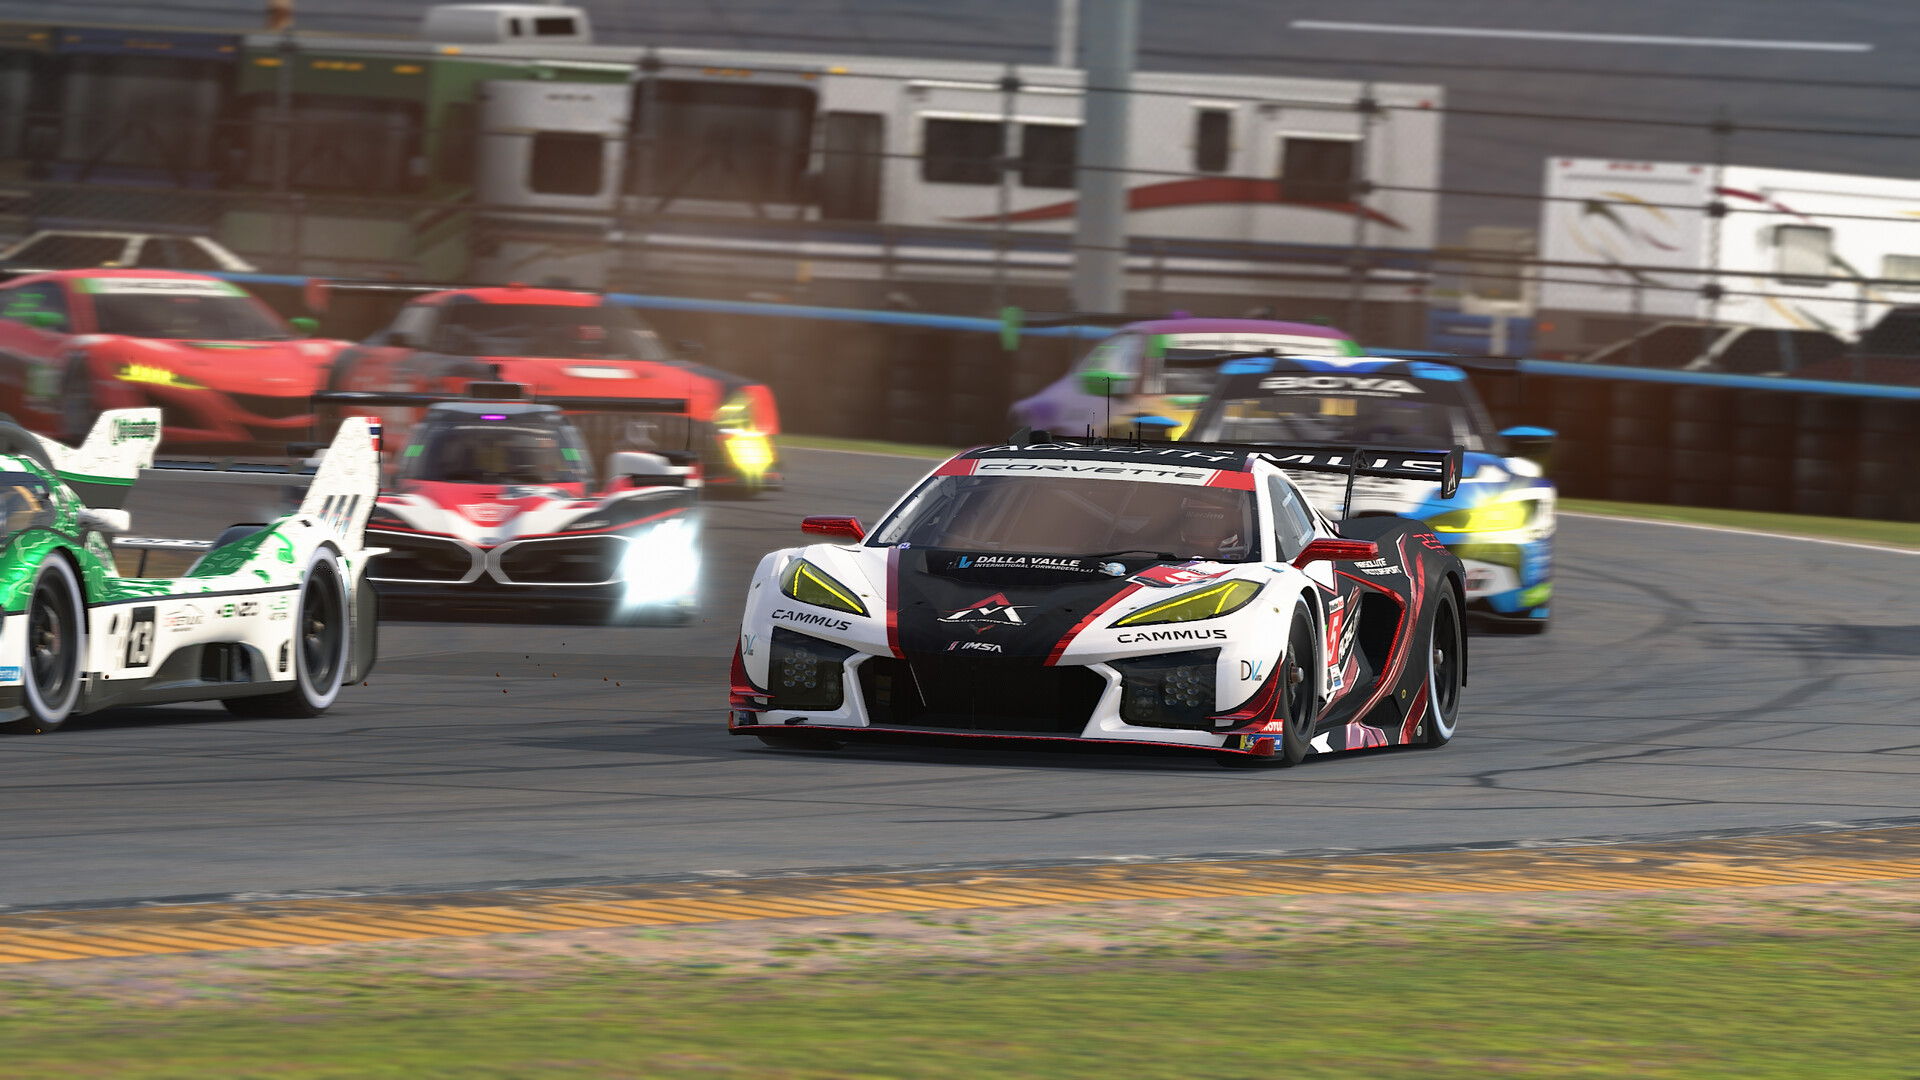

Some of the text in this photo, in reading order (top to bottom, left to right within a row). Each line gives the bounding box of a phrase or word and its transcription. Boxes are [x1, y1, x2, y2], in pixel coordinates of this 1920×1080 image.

[1258, 377, 1425, 394] BOYA
[980, 463, 1205, 480] CORVETTE
[976, 556, 1081, 567] DALLA VALLE
[1031, 564, 1079, 572] FORWARDERS
[771, 609, 852, 631] CAMMUS
[1117, 629, 1227, 643] CAMMUS
[1328, 615, 1340, 662] 5
[961, 642, 1002, 653] IMSA
